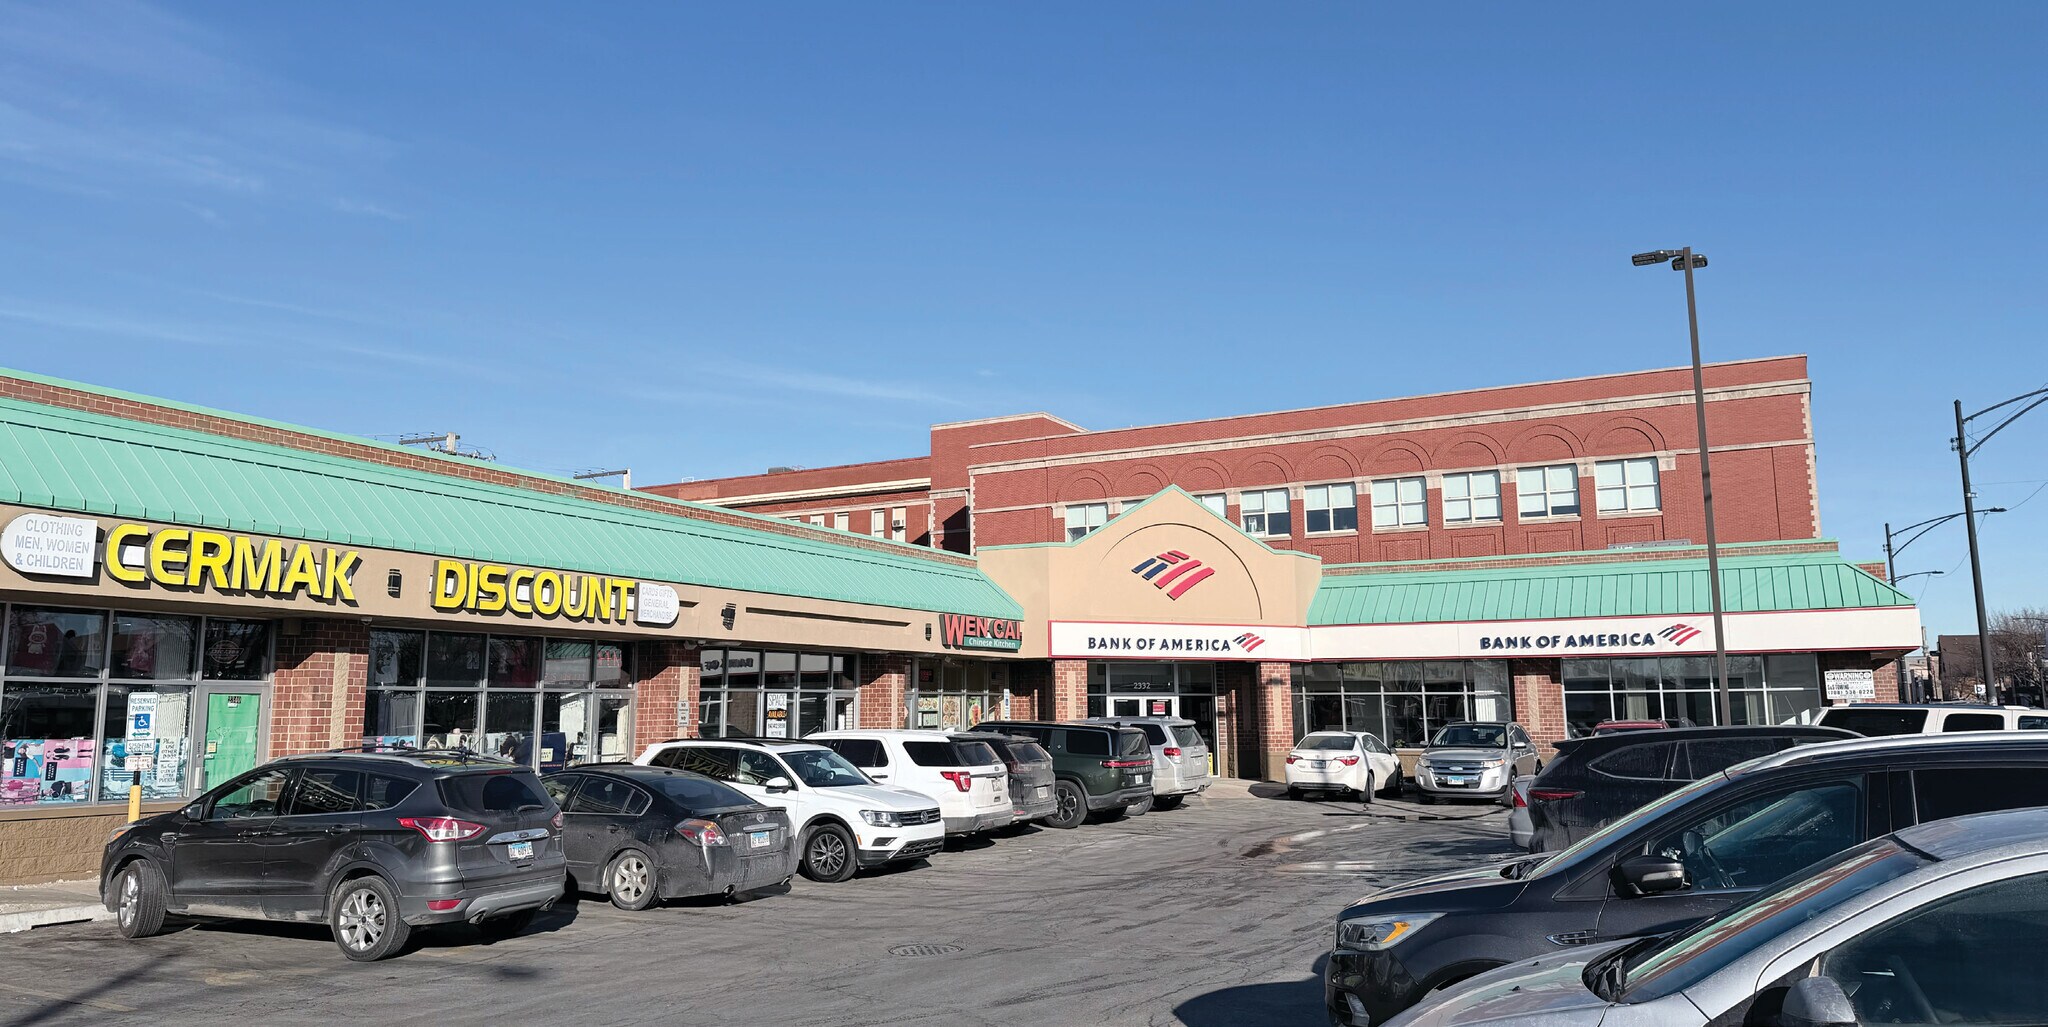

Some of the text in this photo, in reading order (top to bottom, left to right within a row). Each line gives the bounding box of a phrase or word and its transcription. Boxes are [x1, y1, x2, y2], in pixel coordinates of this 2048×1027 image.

[26, 519, 82, 536] CLOTHING
[15, 534, 90, 554] MEN, WOMEN
[15, 552, 84, 570] & CHILDREN
[105, 523, 360, 600] CERMAK
[434, 560, 635, 620] DISCOUNT
[644, 598, 669, 608] GENERAL
[640, 609, 672, 620] MERCHANDISE
[944, 614, 988, 645] WEN
[968, 638, 1016, 648] Chinese Kitchen
[1088, 637, 1230, 651] BANK OF AMERICA
[1480, 632, 1655, 650] BANK OF AMERICA
[769, 694, 786, 706] SPACE
